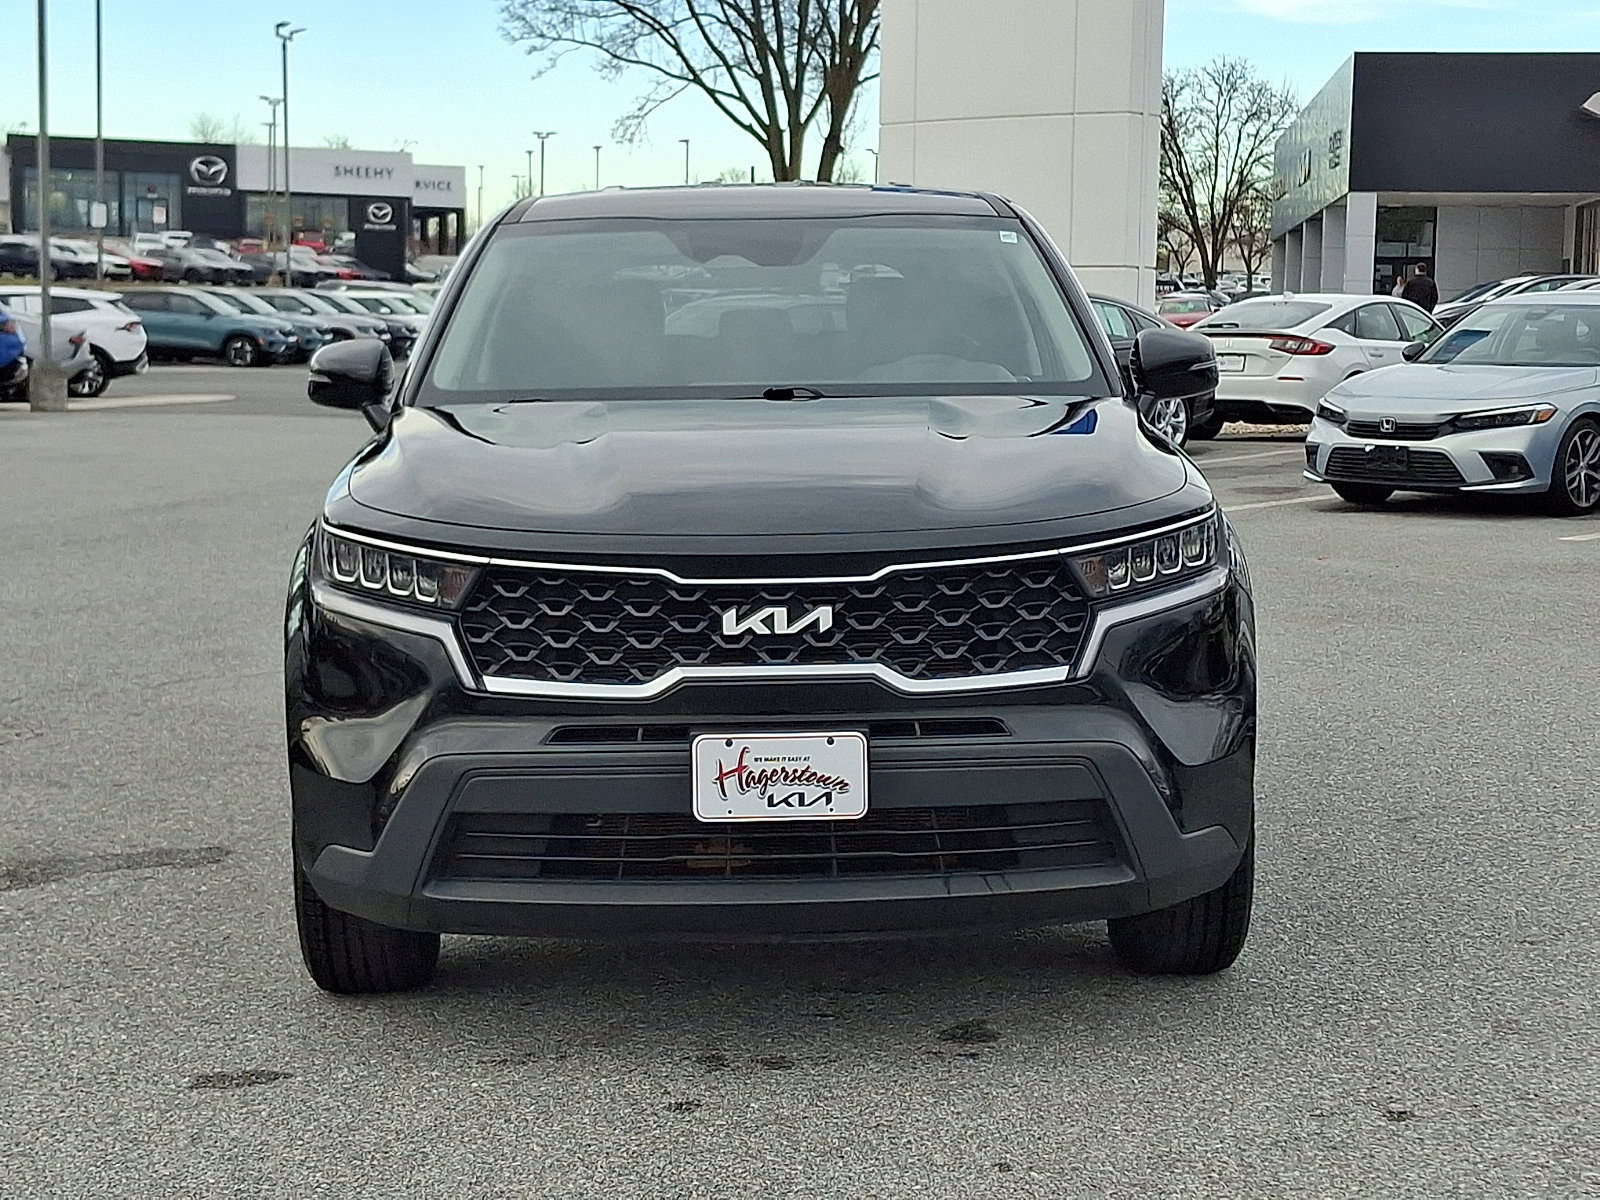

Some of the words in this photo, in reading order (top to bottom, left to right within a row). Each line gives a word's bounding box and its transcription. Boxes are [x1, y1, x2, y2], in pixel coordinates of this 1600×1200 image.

[335, 165, 394, 179] SHEEHY
[723, 605, 833, 635] KIA
[714, 746, 850, 799] Hagerstown
[767, 792, 833, 807] KIA
